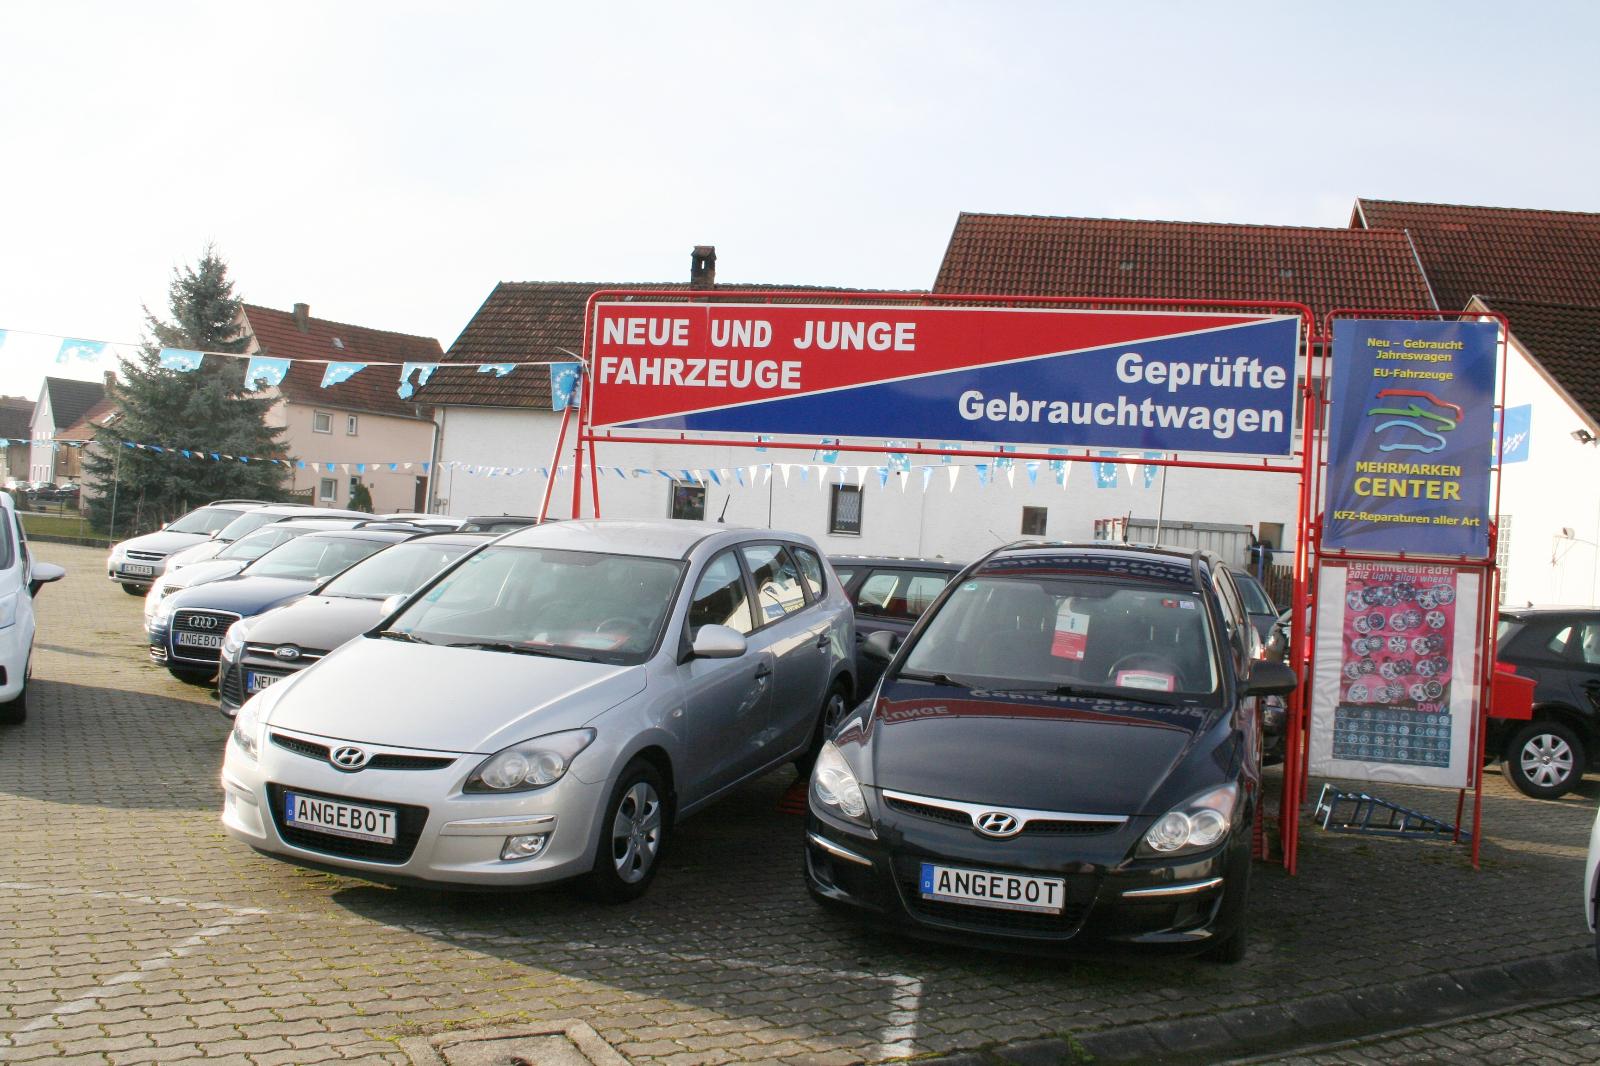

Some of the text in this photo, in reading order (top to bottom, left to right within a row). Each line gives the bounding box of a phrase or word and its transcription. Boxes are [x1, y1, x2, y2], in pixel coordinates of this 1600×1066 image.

[603, 317, 916, 351] NEUE UND JUNGE
[1367, 338, 1390, 349] Neu
[1403, 339, 1464, 350] Gebraucht
[1376, 350, 1452, 363] Jahreswagen
[599, 356, 802, 390] FAHRZEUGE
[1115, 352, 1286, 393] Geprüfte
[1373, 368, 1454, 382] EU-Fahrzeuge
[958, 390, 1284, 439] Gebrauchtwagen
[1355, 461, 1461, 477] MEHRMARKEN
[1353, 477, 1462, 501] CENTER
[1333, 510, 1480, 527] KFZ-Reparaturen aller Art
[1348, 570, 1369, 579] 2012
[179, 632, 224, 649] ANGEBOT
[298, 799, 391, 834] ANGEBOT
[937, 870, 1058, 904] ANGEBOT
